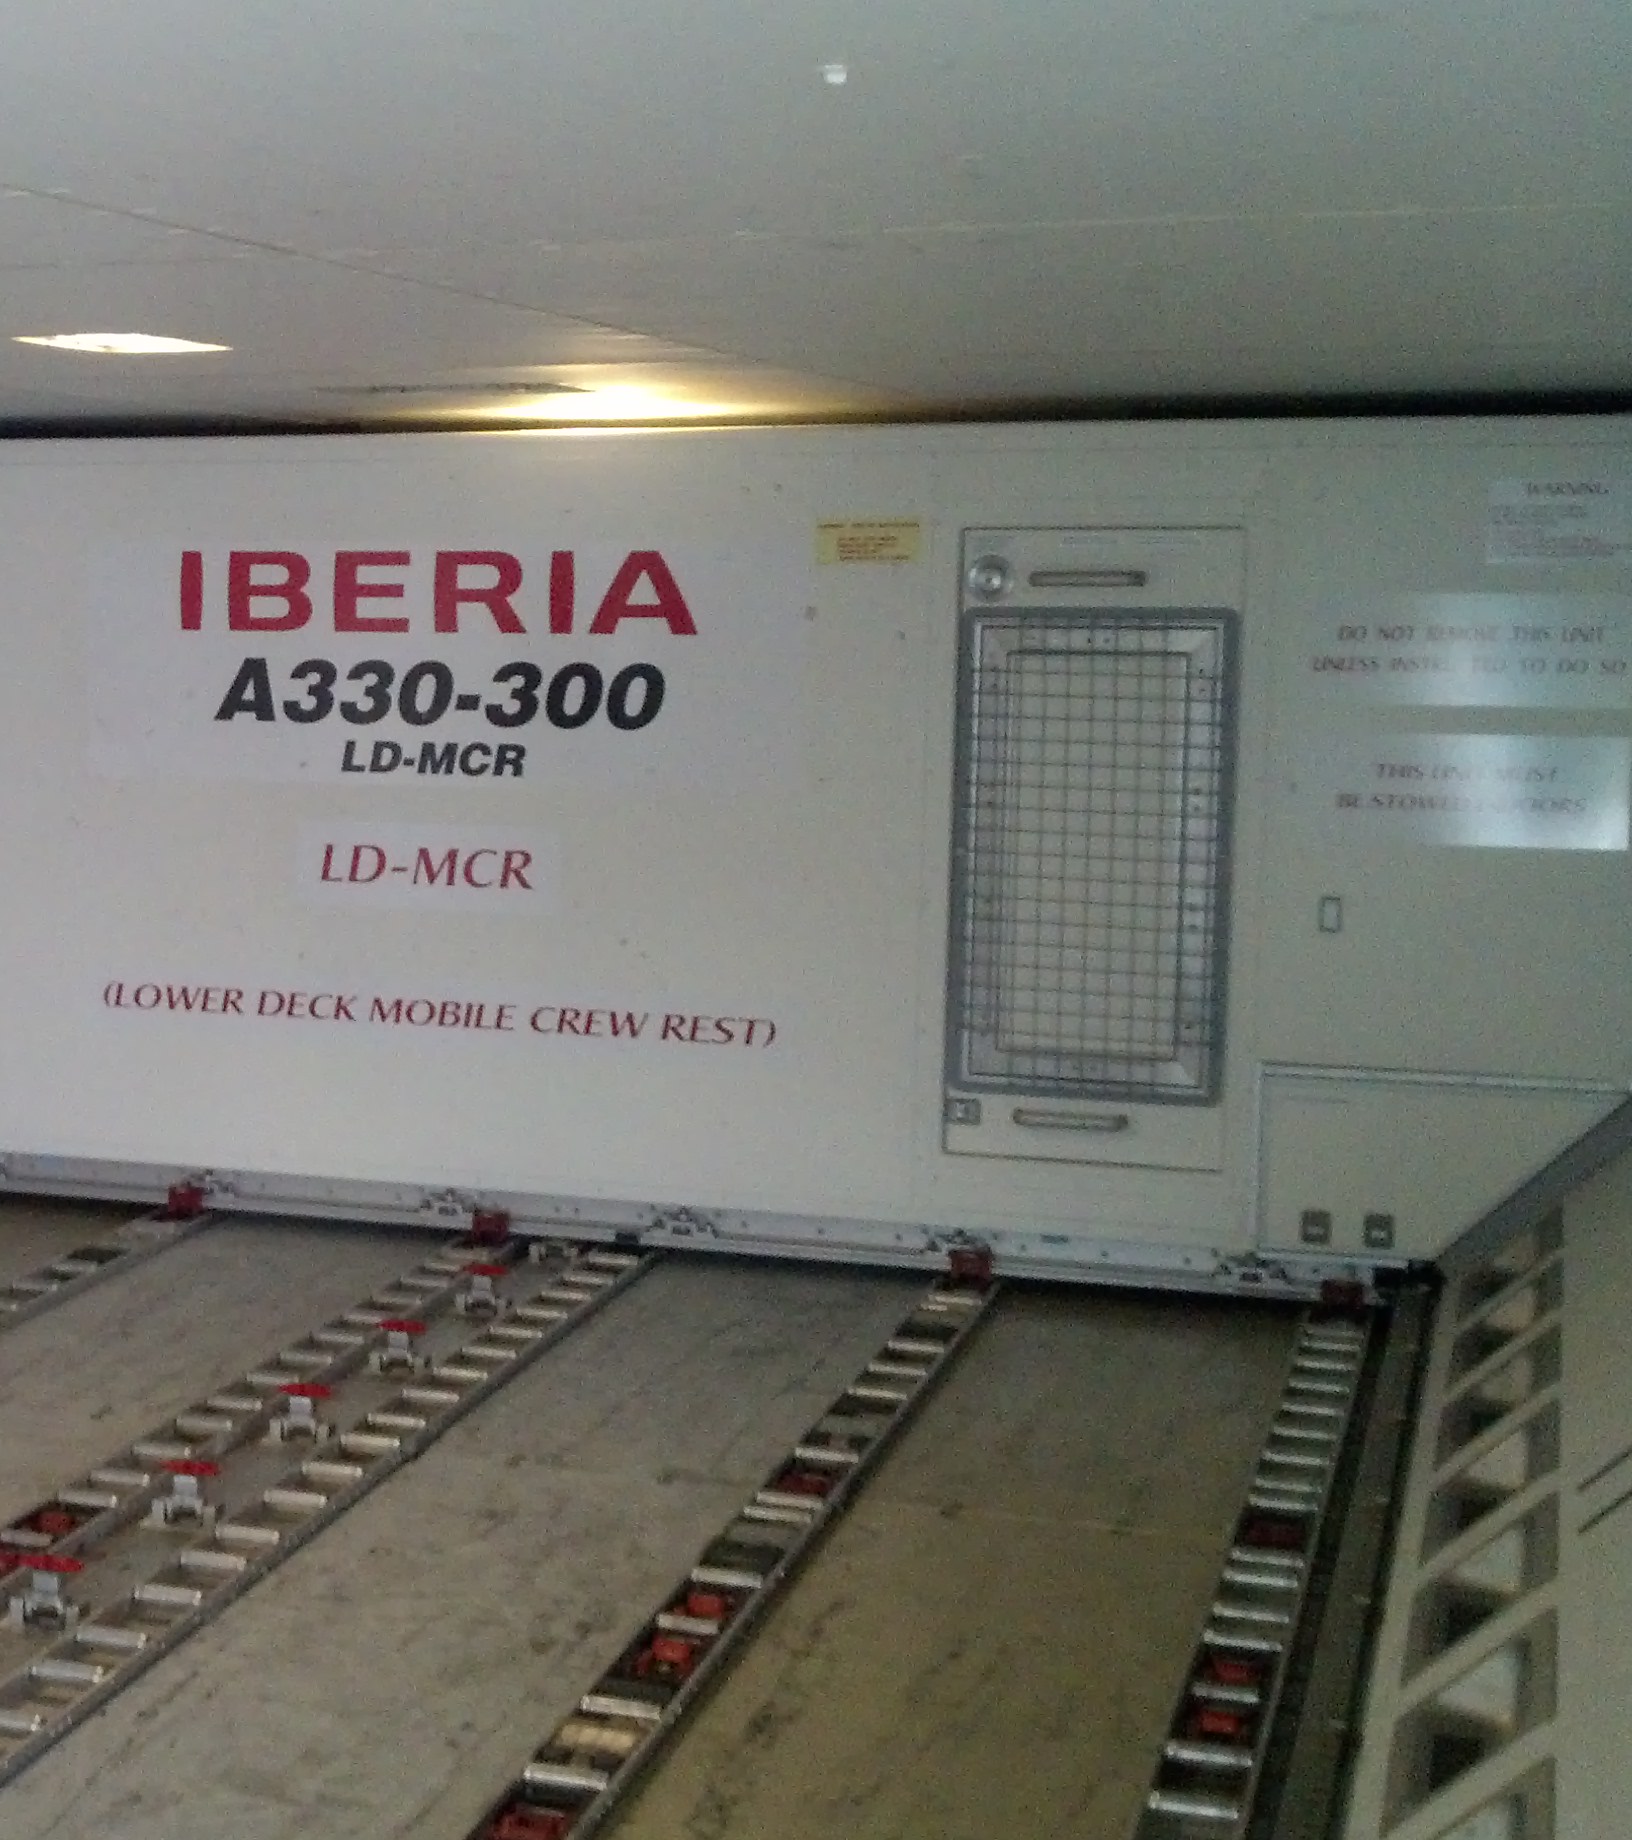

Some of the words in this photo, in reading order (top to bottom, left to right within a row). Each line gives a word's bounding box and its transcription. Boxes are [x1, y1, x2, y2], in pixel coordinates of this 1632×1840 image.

[179, 550, 698, 636] IBERIA
[1337, 625, 1368, 643] DO
[1377, 625, 1416, 643] NOT
[1519, 657, 1547, 675] TO
[1556, 657, 1590, 676] DO
[214, 657, 666, 731] A330-300
[340, 739, 526, 777] LD-MCR
[320, 843, 533, 890] LD-MCR
[103, 979, 244, 1015] (LOWER
[257, 989, 358, 1022] DECK
[369, 996, 517, 1032] MOBILE
[530, 1005, 649, 1039] CREW
[661, 1013, 777, 1048] REST)
